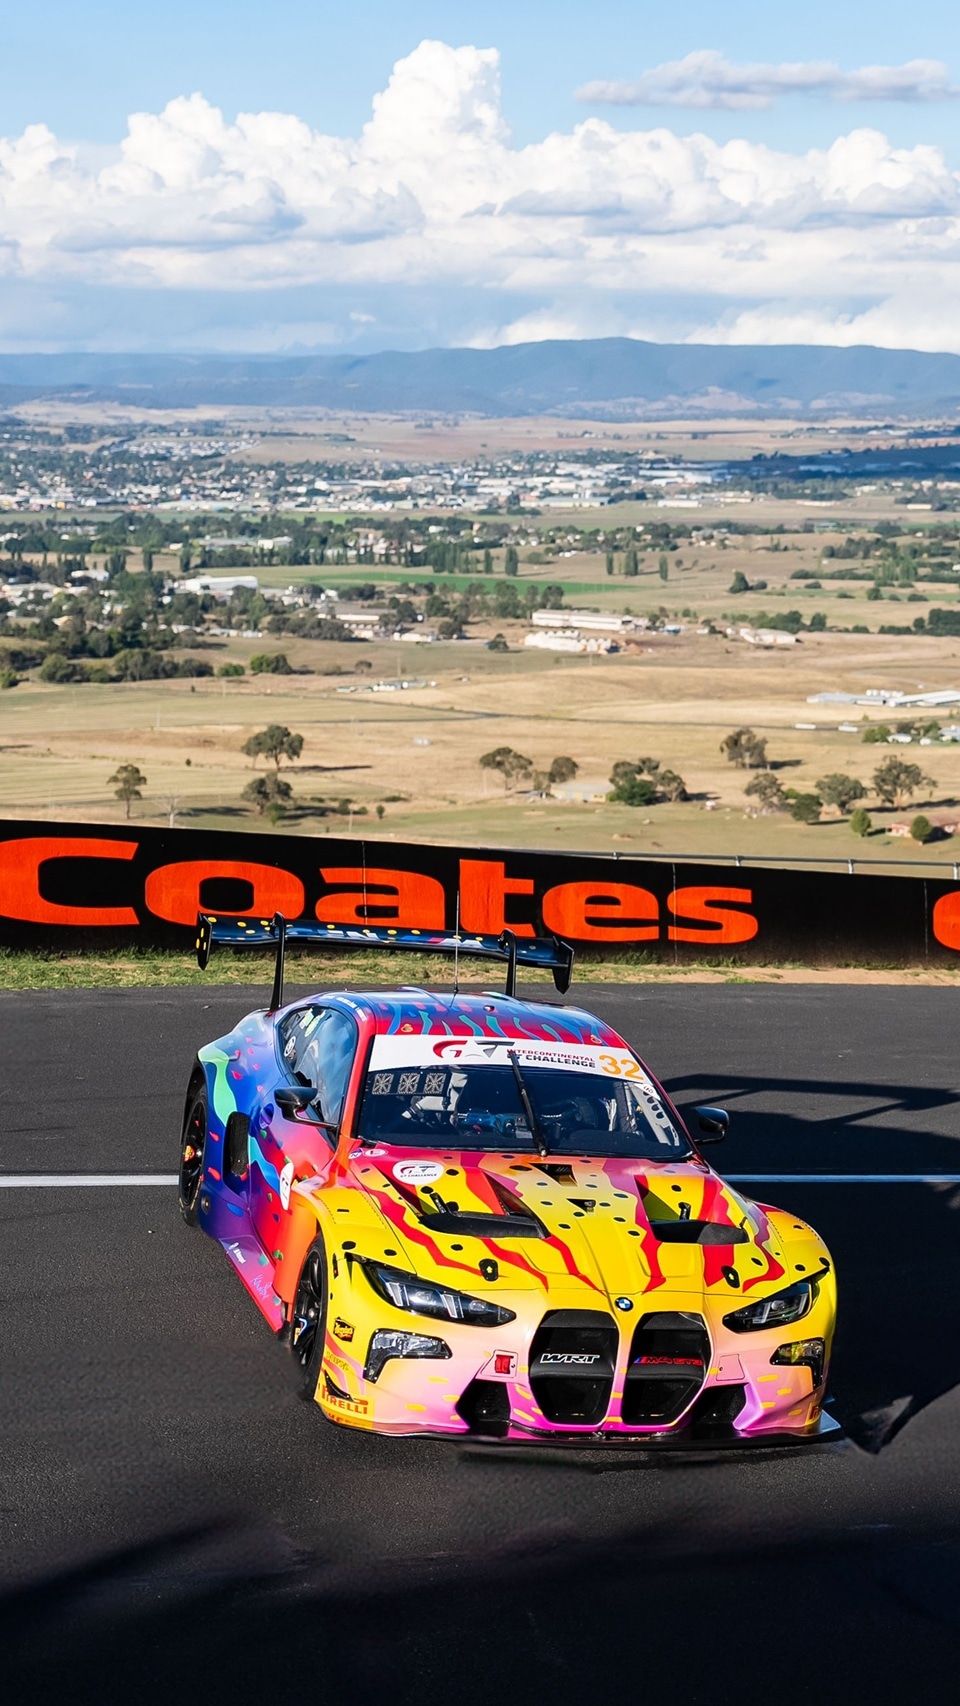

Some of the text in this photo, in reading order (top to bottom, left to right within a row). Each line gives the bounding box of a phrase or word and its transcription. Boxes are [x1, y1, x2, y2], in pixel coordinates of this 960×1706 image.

[0, 837, 758, 944] Coates
[525, 1054, 596, 1069] CHALLENGE
[598, 1054, 644, 1081] 32
[540, 1353, 600, 1364] WRT
